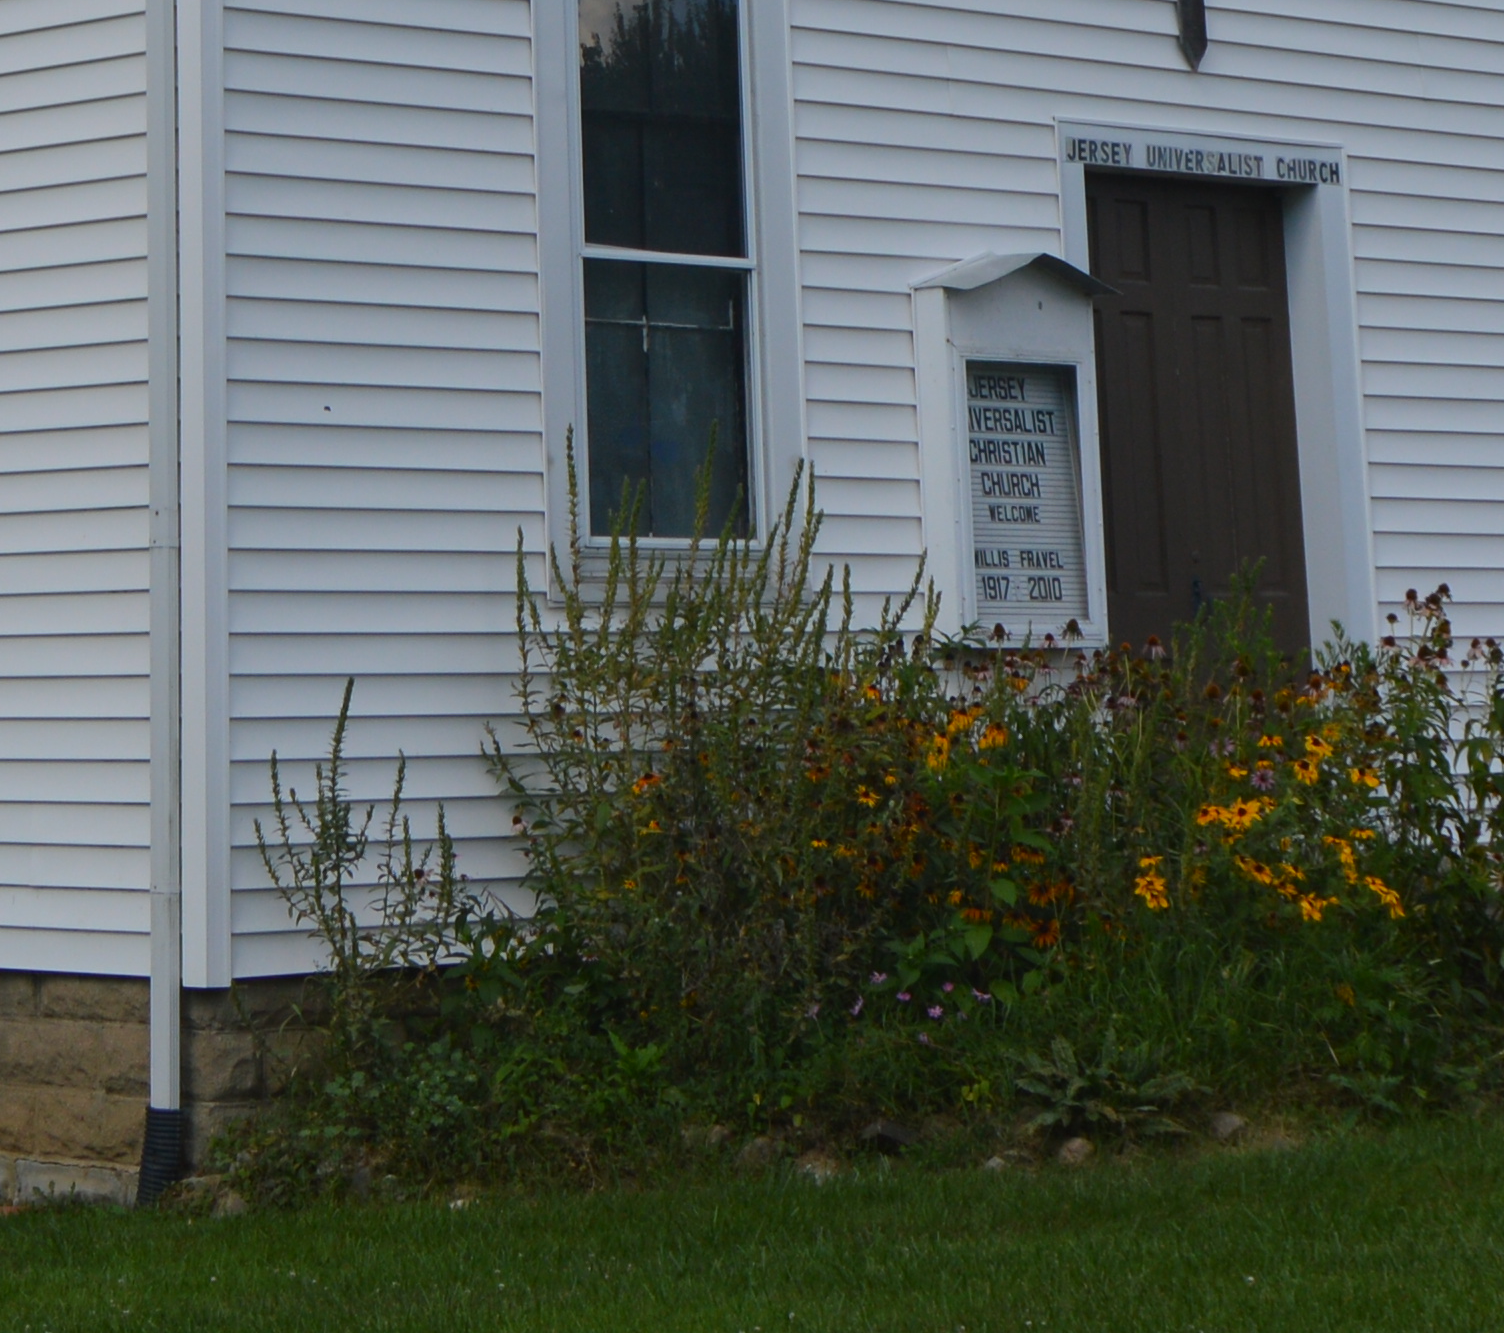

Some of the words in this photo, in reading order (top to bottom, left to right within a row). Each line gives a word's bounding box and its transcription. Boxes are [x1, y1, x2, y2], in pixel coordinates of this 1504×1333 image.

[1067, 138, 1132, 165] JERSEY
[1146, 144, 1263, 177] UNIVERSALIST
[1276, 157, 1340, 184] CHURCH
[968, 375, 1026, 401] JERSEY
[969, 439, 1046, 465] CHRISTIAN
[980, 471, 1041, 498] CHURCH
[988, 504, 1041, 523] WELCOME
[1019, 550, 1064, 569] FRAVEL
[981, 575, 1010, 600] 1917
[1027, 576, 1063, 601] 2010
